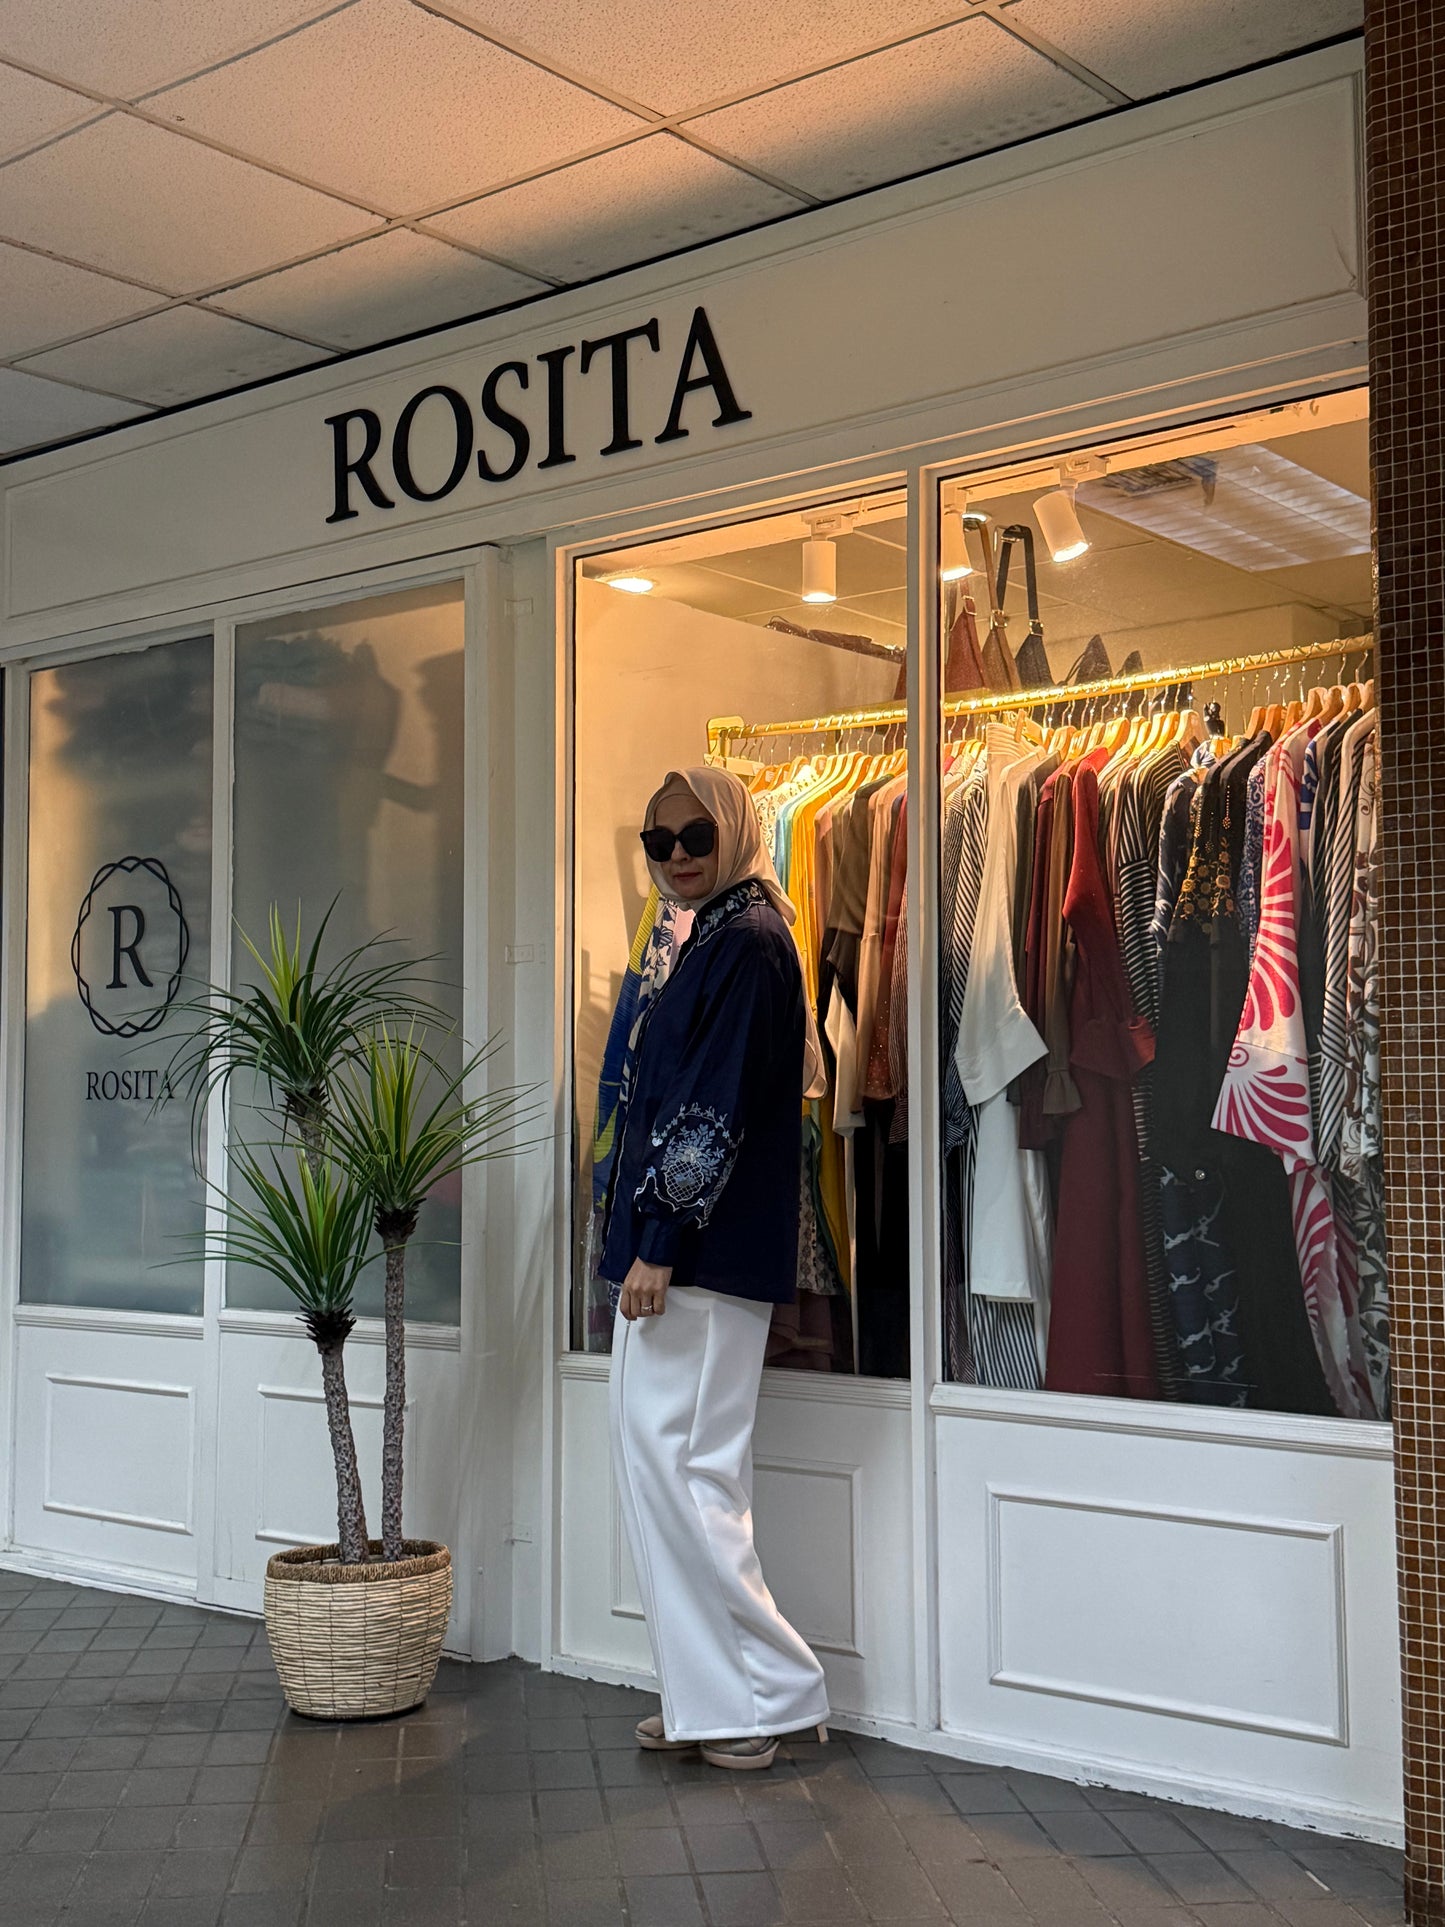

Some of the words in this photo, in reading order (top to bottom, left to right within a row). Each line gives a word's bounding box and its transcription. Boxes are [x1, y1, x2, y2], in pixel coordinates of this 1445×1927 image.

[324, 306, 752, 524] ROSITA
[106, 905, 153, 989] R
[86, 1069, 175, 1101] ROSITA
